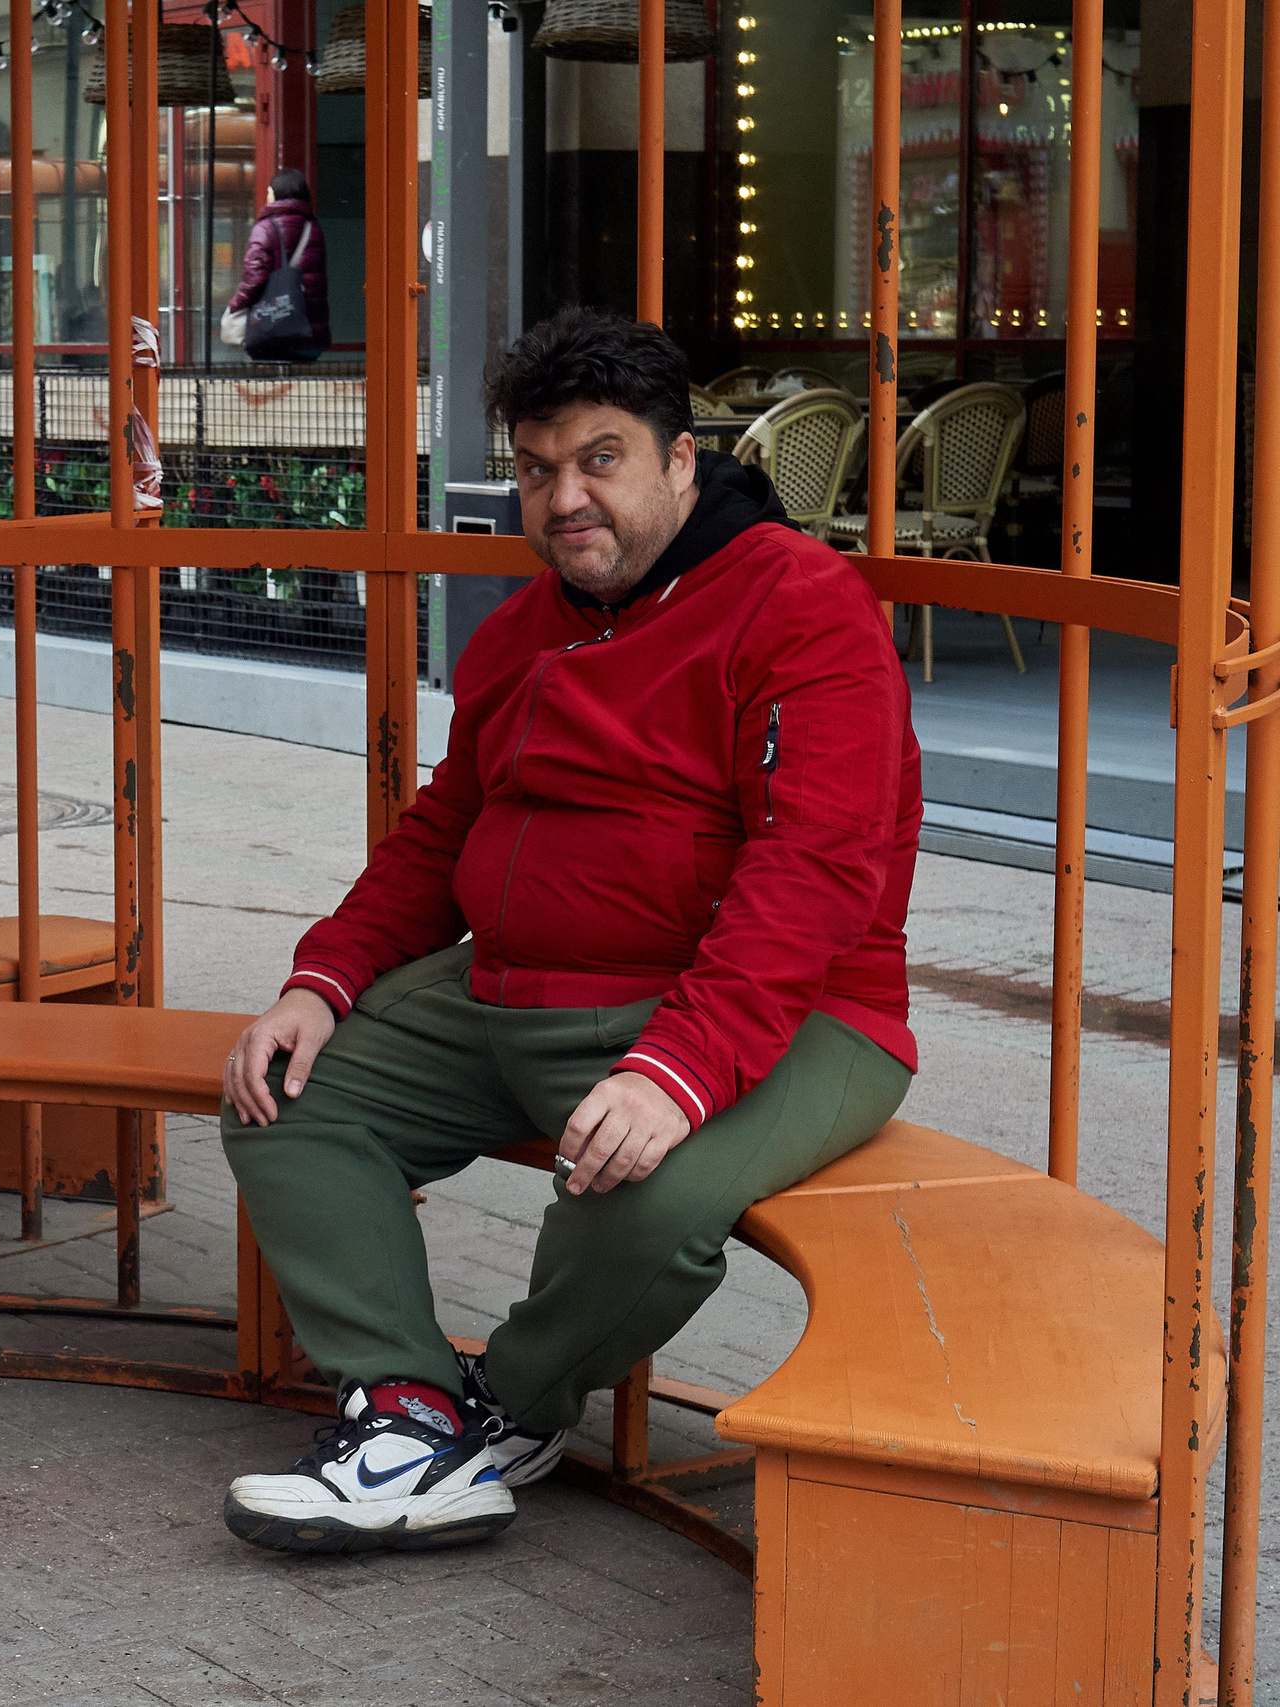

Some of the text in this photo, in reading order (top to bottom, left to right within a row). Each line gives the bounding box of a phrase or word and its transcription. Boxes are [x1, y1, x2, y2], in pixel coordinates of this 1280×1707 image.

[437, 66, 446, 131] #GRABLYRU
[436, 220, 445, 285] #GRABLYRU
[435, 374, 444, 438] #GRABLYRU
